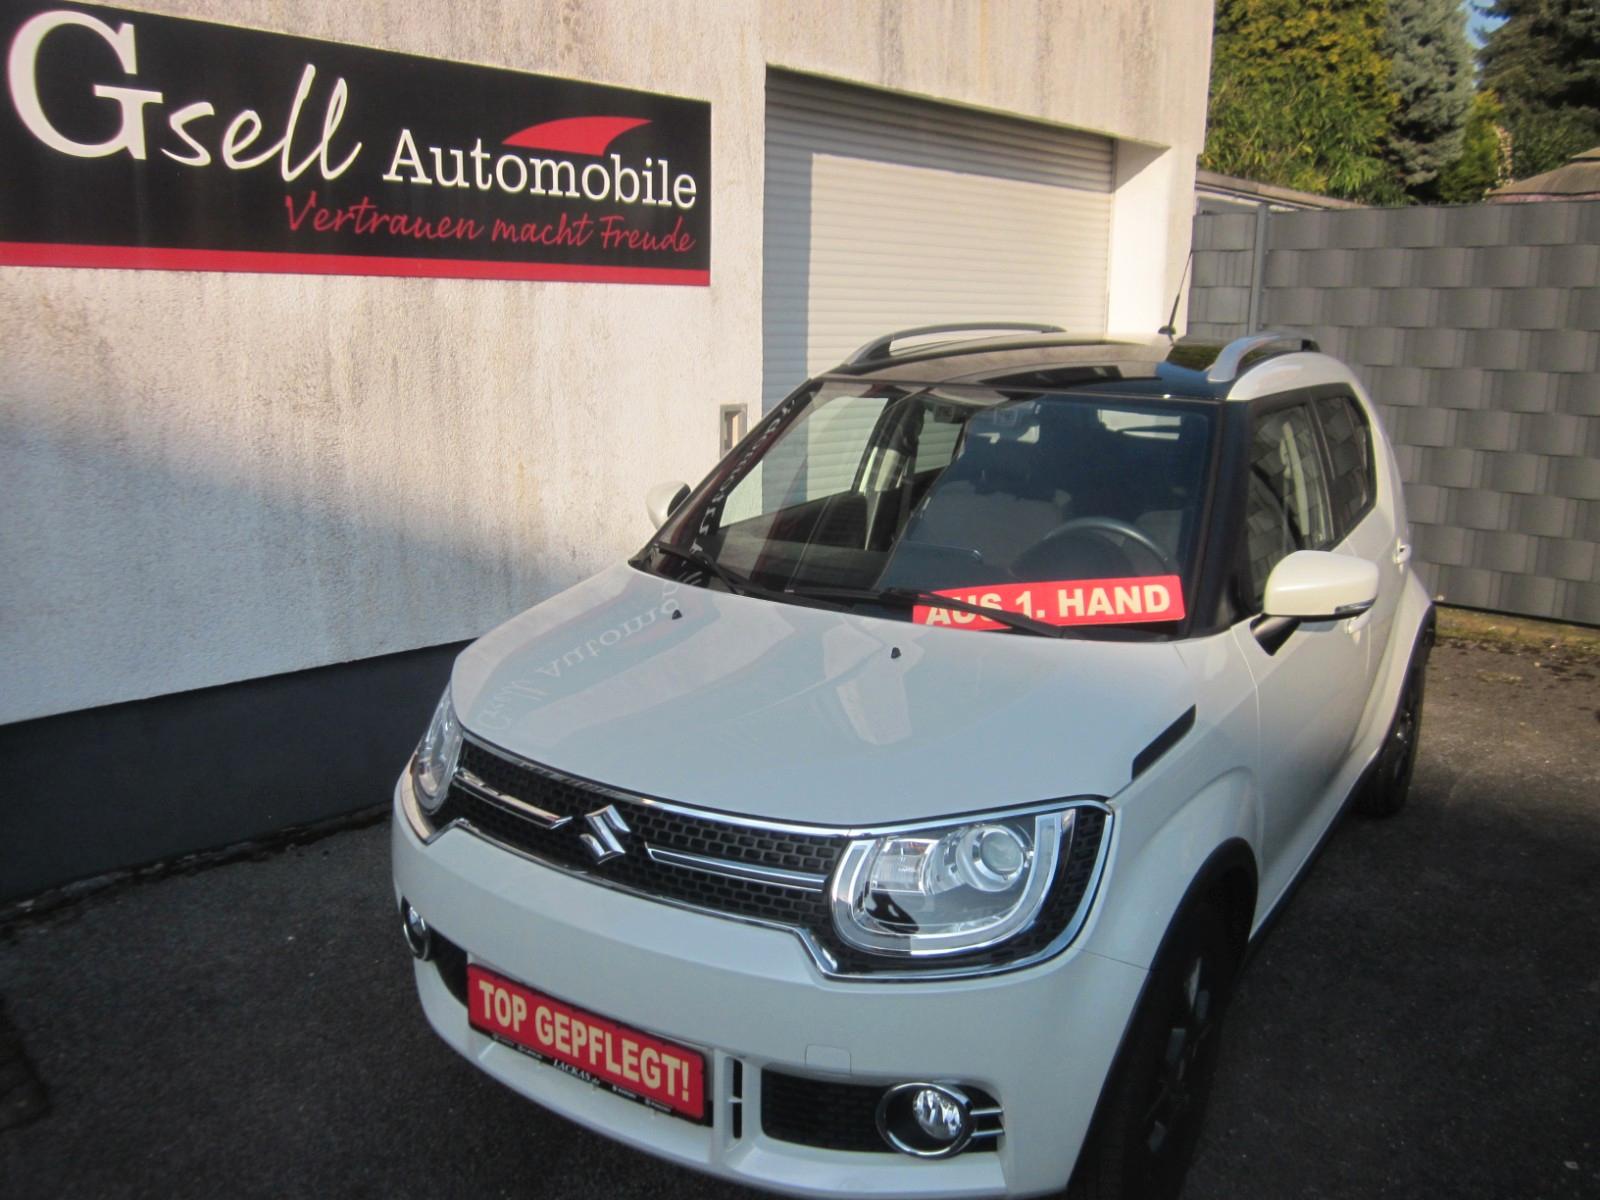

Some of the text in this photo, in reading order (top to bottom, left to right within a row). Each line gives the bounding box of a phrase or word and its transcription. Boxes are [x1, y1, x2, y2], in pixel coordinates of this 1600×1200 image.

[8, 10, 698, 208] Gsell Automobile
[285, 191, 697, 253] Vertrauen macht Freude
[1015, 591, 1046, 619] 1.
[1057, 584, 1170, 618] HAND
[479, 980, 690, 1103] TOP GEPFLEGT!
